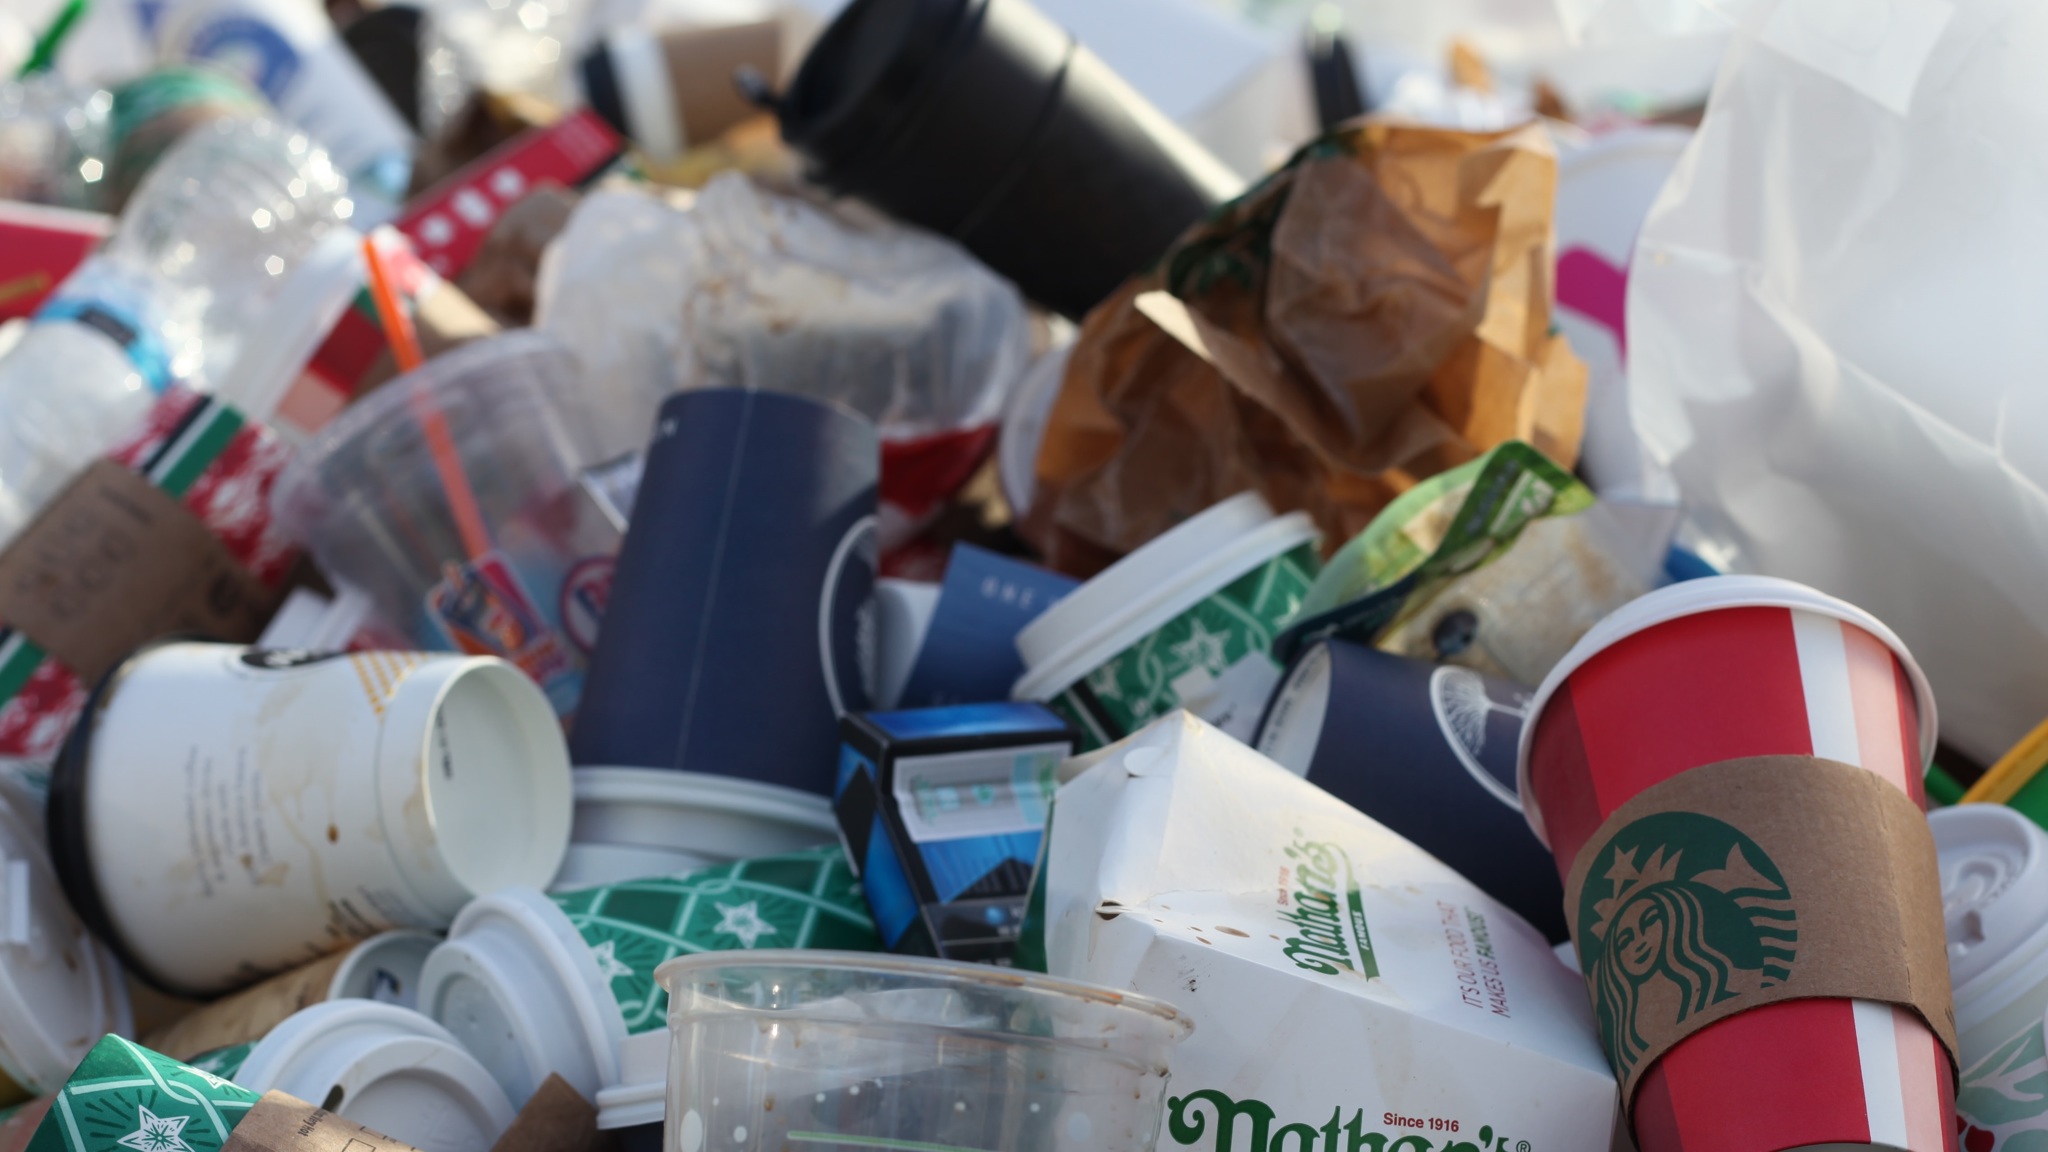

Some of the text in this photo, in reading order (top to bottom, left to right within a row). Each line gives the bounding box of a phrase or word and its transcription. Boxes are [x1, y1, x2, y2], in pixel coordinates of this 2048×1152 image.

[1445, 928, 1470, 959] FOOD
[1454, 960, 1477, 984] OUR
[1479, 959, 1500, 976] US
[1460, 985, 1483, 1008] IT'S
[1483, 976, 1511, 1018] MAKES
[1168, 1089, 1509, 1152] Nath'
[1383, 1113, 1459, 1132] Since 1916
